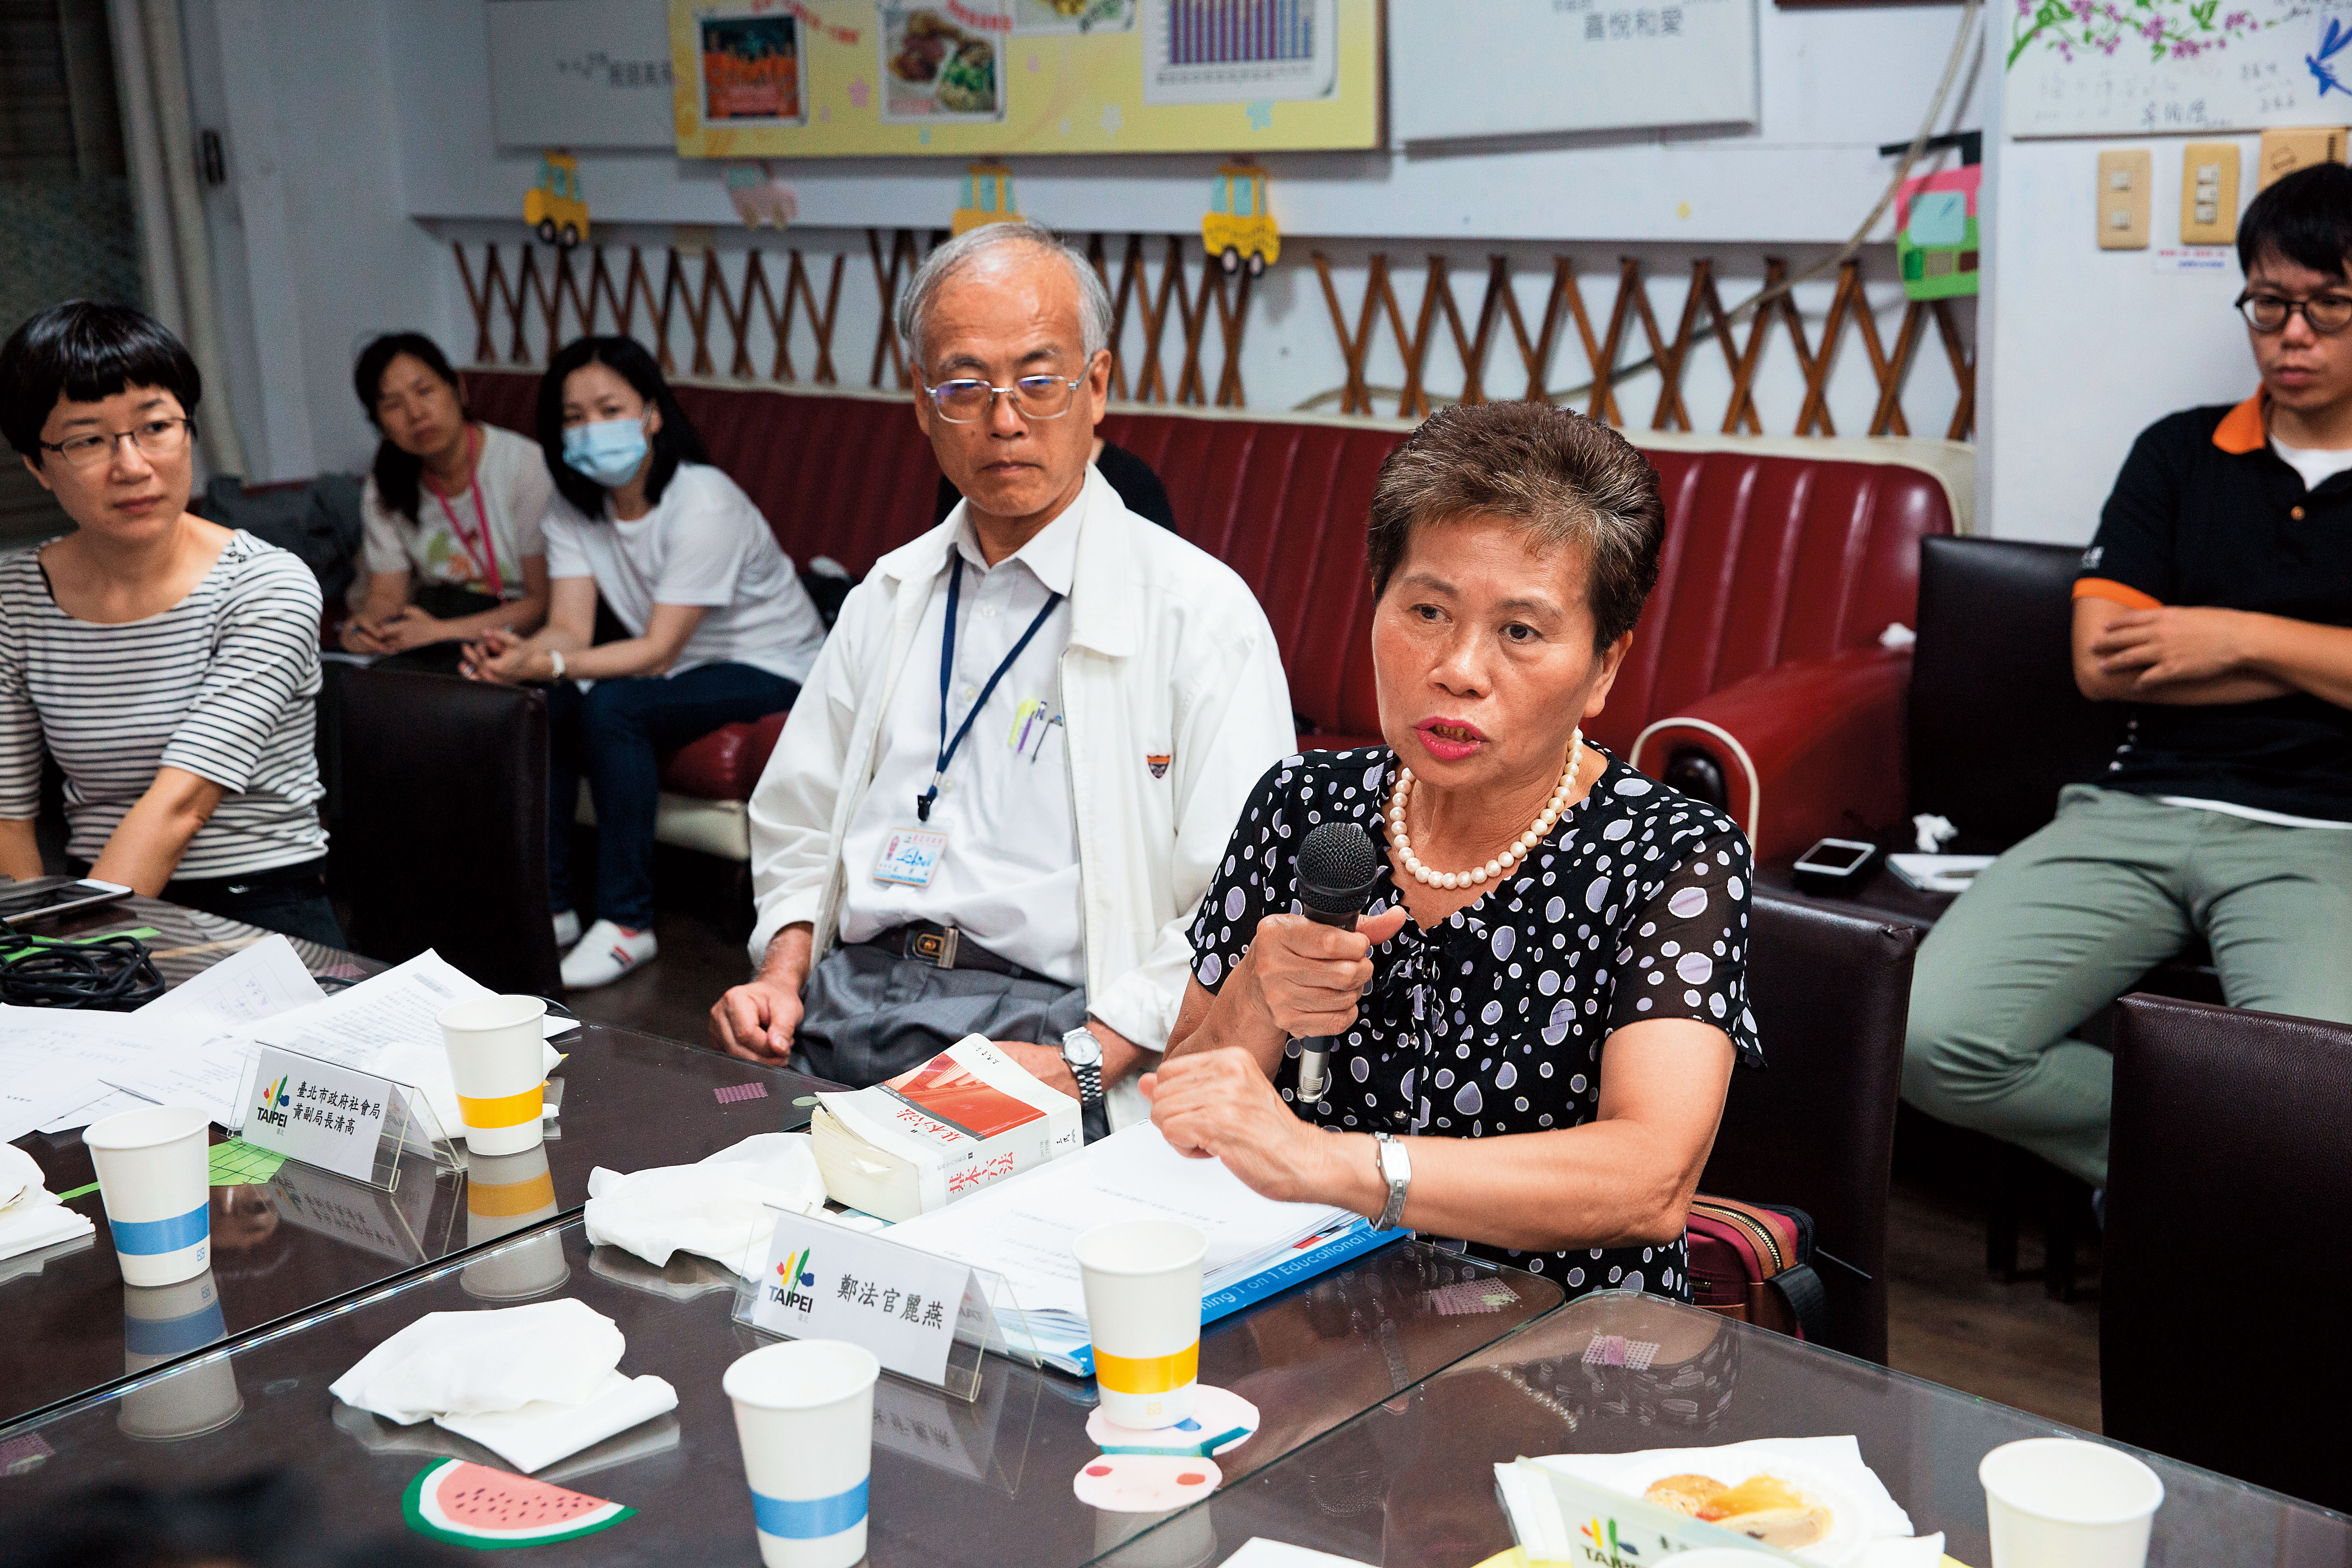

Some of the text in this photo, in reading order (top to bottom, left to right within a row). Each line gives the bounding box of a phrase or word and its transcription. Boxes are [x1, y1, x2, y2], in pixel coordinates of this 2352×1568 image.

[257, 1107, 287, 1128] TAIPEI
[296, 1081, 381, 1120] 臺北市政府社會局
[293, 1102, 356, 1136] 黃副局長清高
[897, 1109, 964, 1142] 基本六法
[949, 1152, 1013, 1194] 基本六法
[1247, 1277, 1270, 1290] on
[1267, 1271, 1280, 1279] 1
[1278, 1234, 1367, 1275] Educational
[768, 1285, 813, 1314] TAIPEI
[837, 1273, 944, 1330] 鄭法官麗燕
